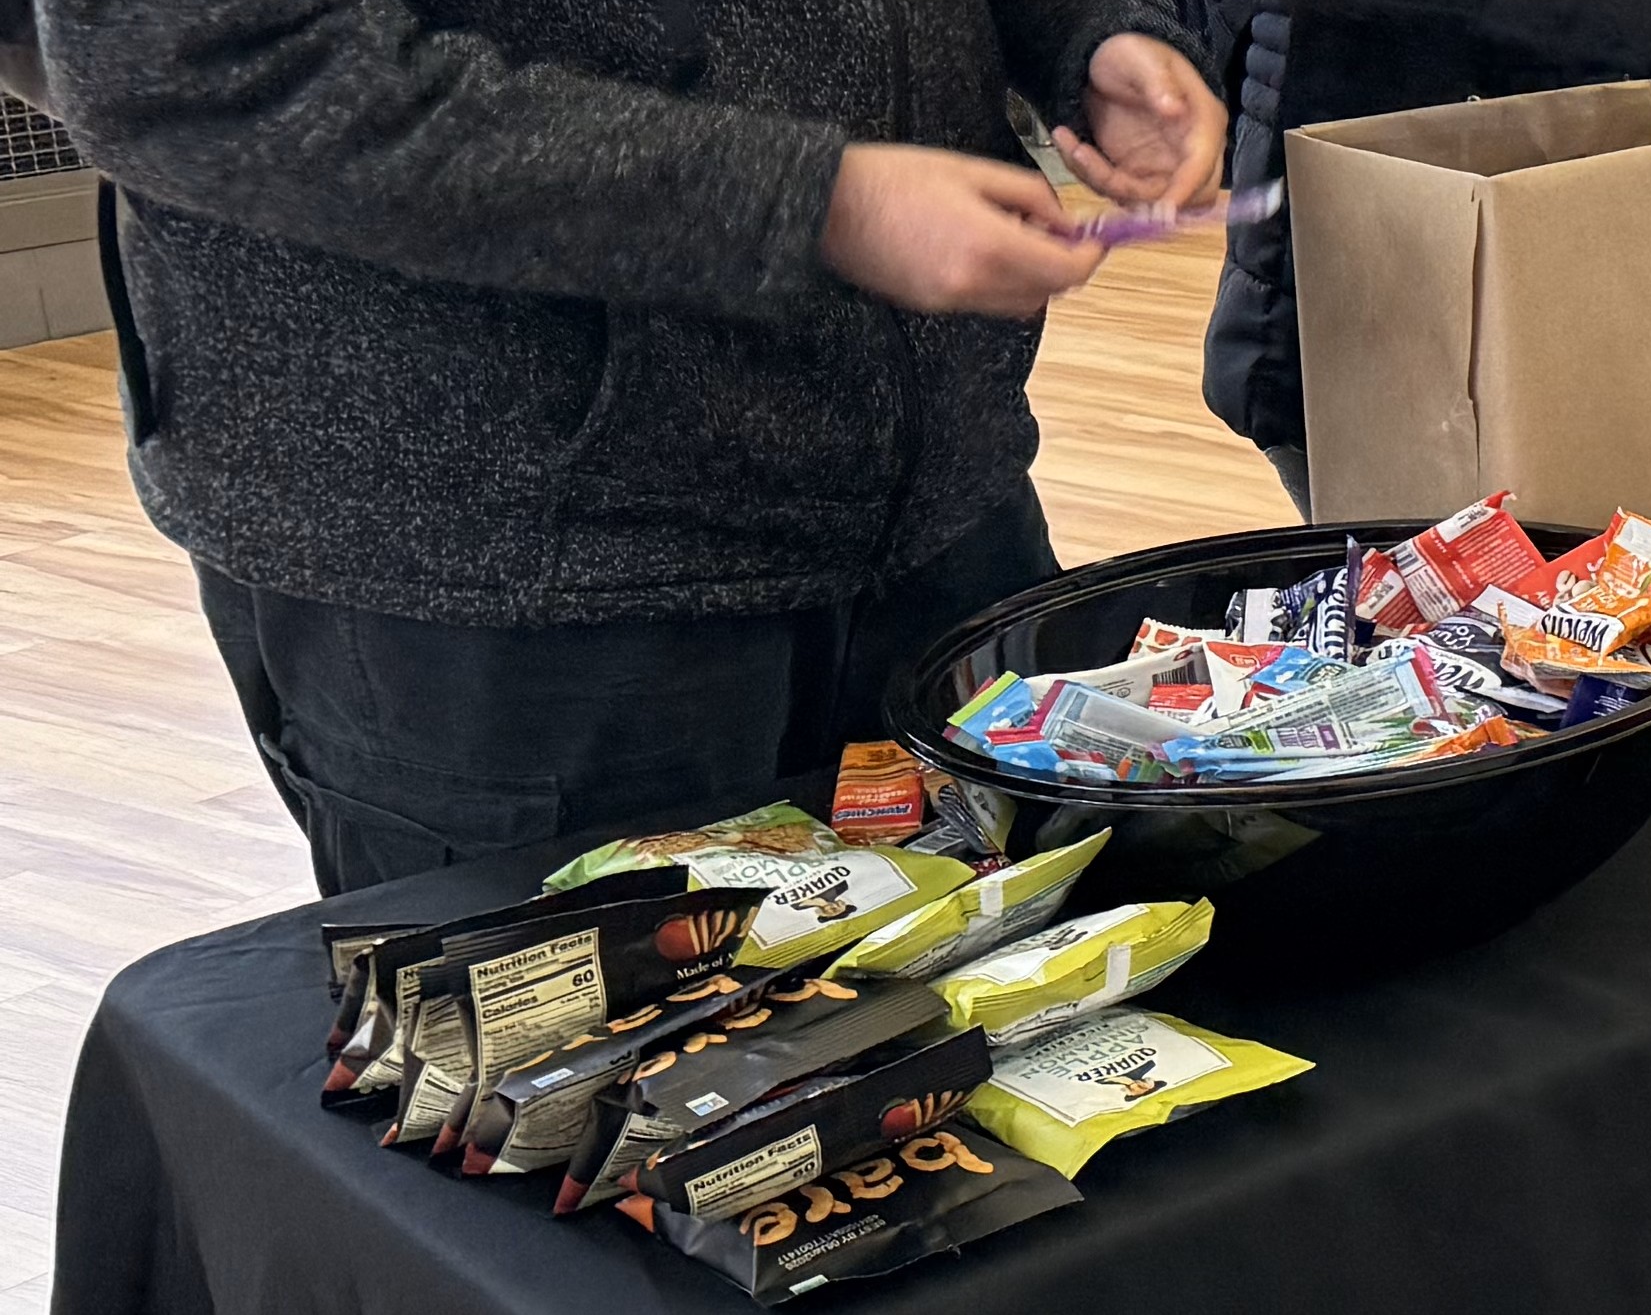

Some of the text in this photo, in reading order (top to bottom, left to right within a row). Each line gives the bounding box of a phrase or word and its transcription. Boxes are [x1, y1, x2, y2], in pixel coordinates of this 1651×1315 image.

[476, 933, 594, 980] Nutrition Facts
[675, 961, 701, 981] Made
[571, 968, 595, 988] 60
[482, 992, 539, 1021] Calories
[1048, 1034, 1144, 1079] APPLE
[1077, 1047, 1158, 1083] QUAKER
[692, 1134, 813, 1193] Nutrition Facts
